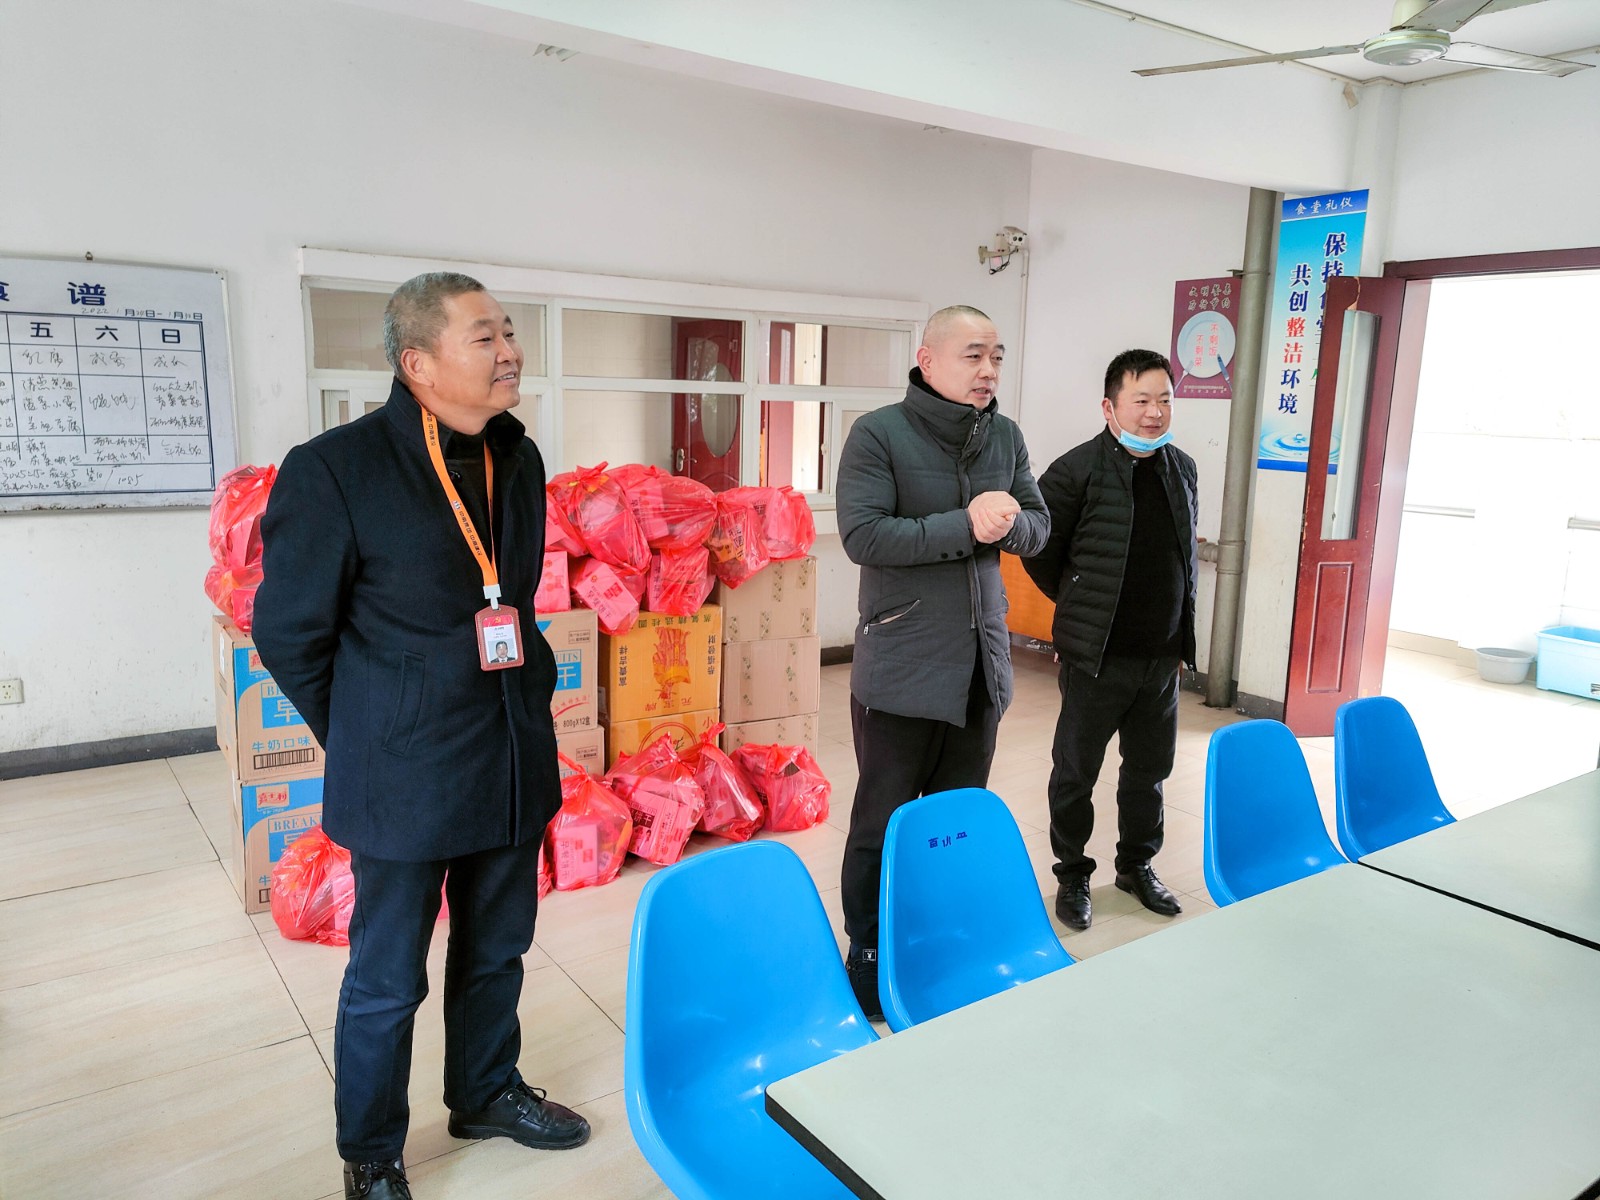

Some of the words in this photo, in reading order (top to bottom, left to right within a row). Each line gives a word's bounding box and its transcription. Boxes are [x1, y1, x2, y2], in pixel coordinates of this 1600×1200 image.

[1294, 196, 1353, 216] 食堂礼仪
[66, 281, 107, 306] 谱
[30, 321, 53, 338] 五
[95, 325, 118, 341] 六
[161, 328, 181, 343] 日
[1278, 264, 1312, 414] 共创整洁环境
[703, 716, 714, 728] 小
[252, 737, 311, 753] 牛奶口味
[273, 814, 323, 832] BREAK
